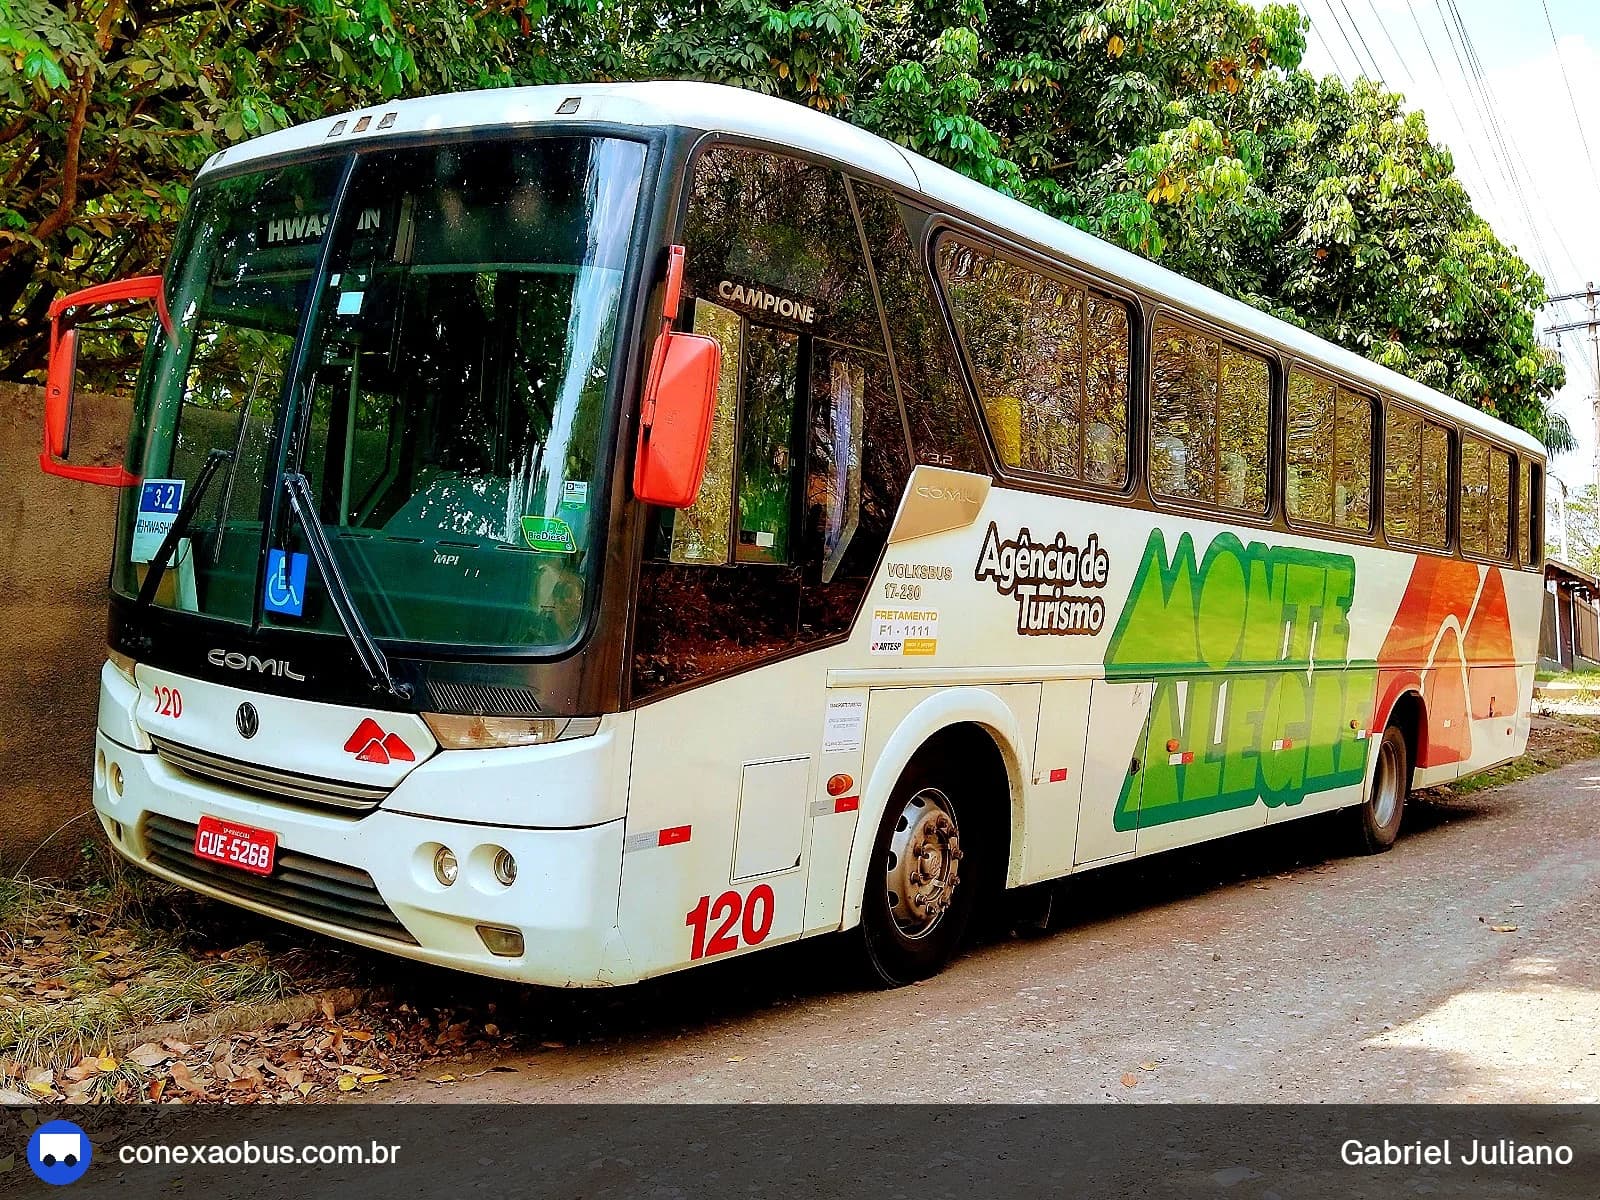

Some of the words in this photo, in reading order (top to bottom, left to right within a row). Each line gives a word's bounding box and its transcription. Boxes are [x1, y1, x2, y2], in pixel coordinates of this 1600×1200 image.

[719, 281, 815, 323] CAMPIONE
[154, 485, 175, 509] 3.2
[528, 530, 569, 542] BioDiesel
[887, 562, 953, 581] VOLKSBUS
[975, 521, 1078, 594] Agência
[1080, 533, 1109, 588] de
[874, 610, 938, 621] FRETAMENTO
[1014, 583, 1105, 635] Turismo
[1104, 527, 1356, 682] MONTE
[878, 642, 902, 651] ARTESP
[880, 625, 892, 636] F1
[904, 625, 929, 636] 1111
[208, 649, 305, 681] COMIL
[154, 686, 182, 718] 120
[1114, 670, 1376, 832] ALEGRE
[685, 884, 775, 960] 120
